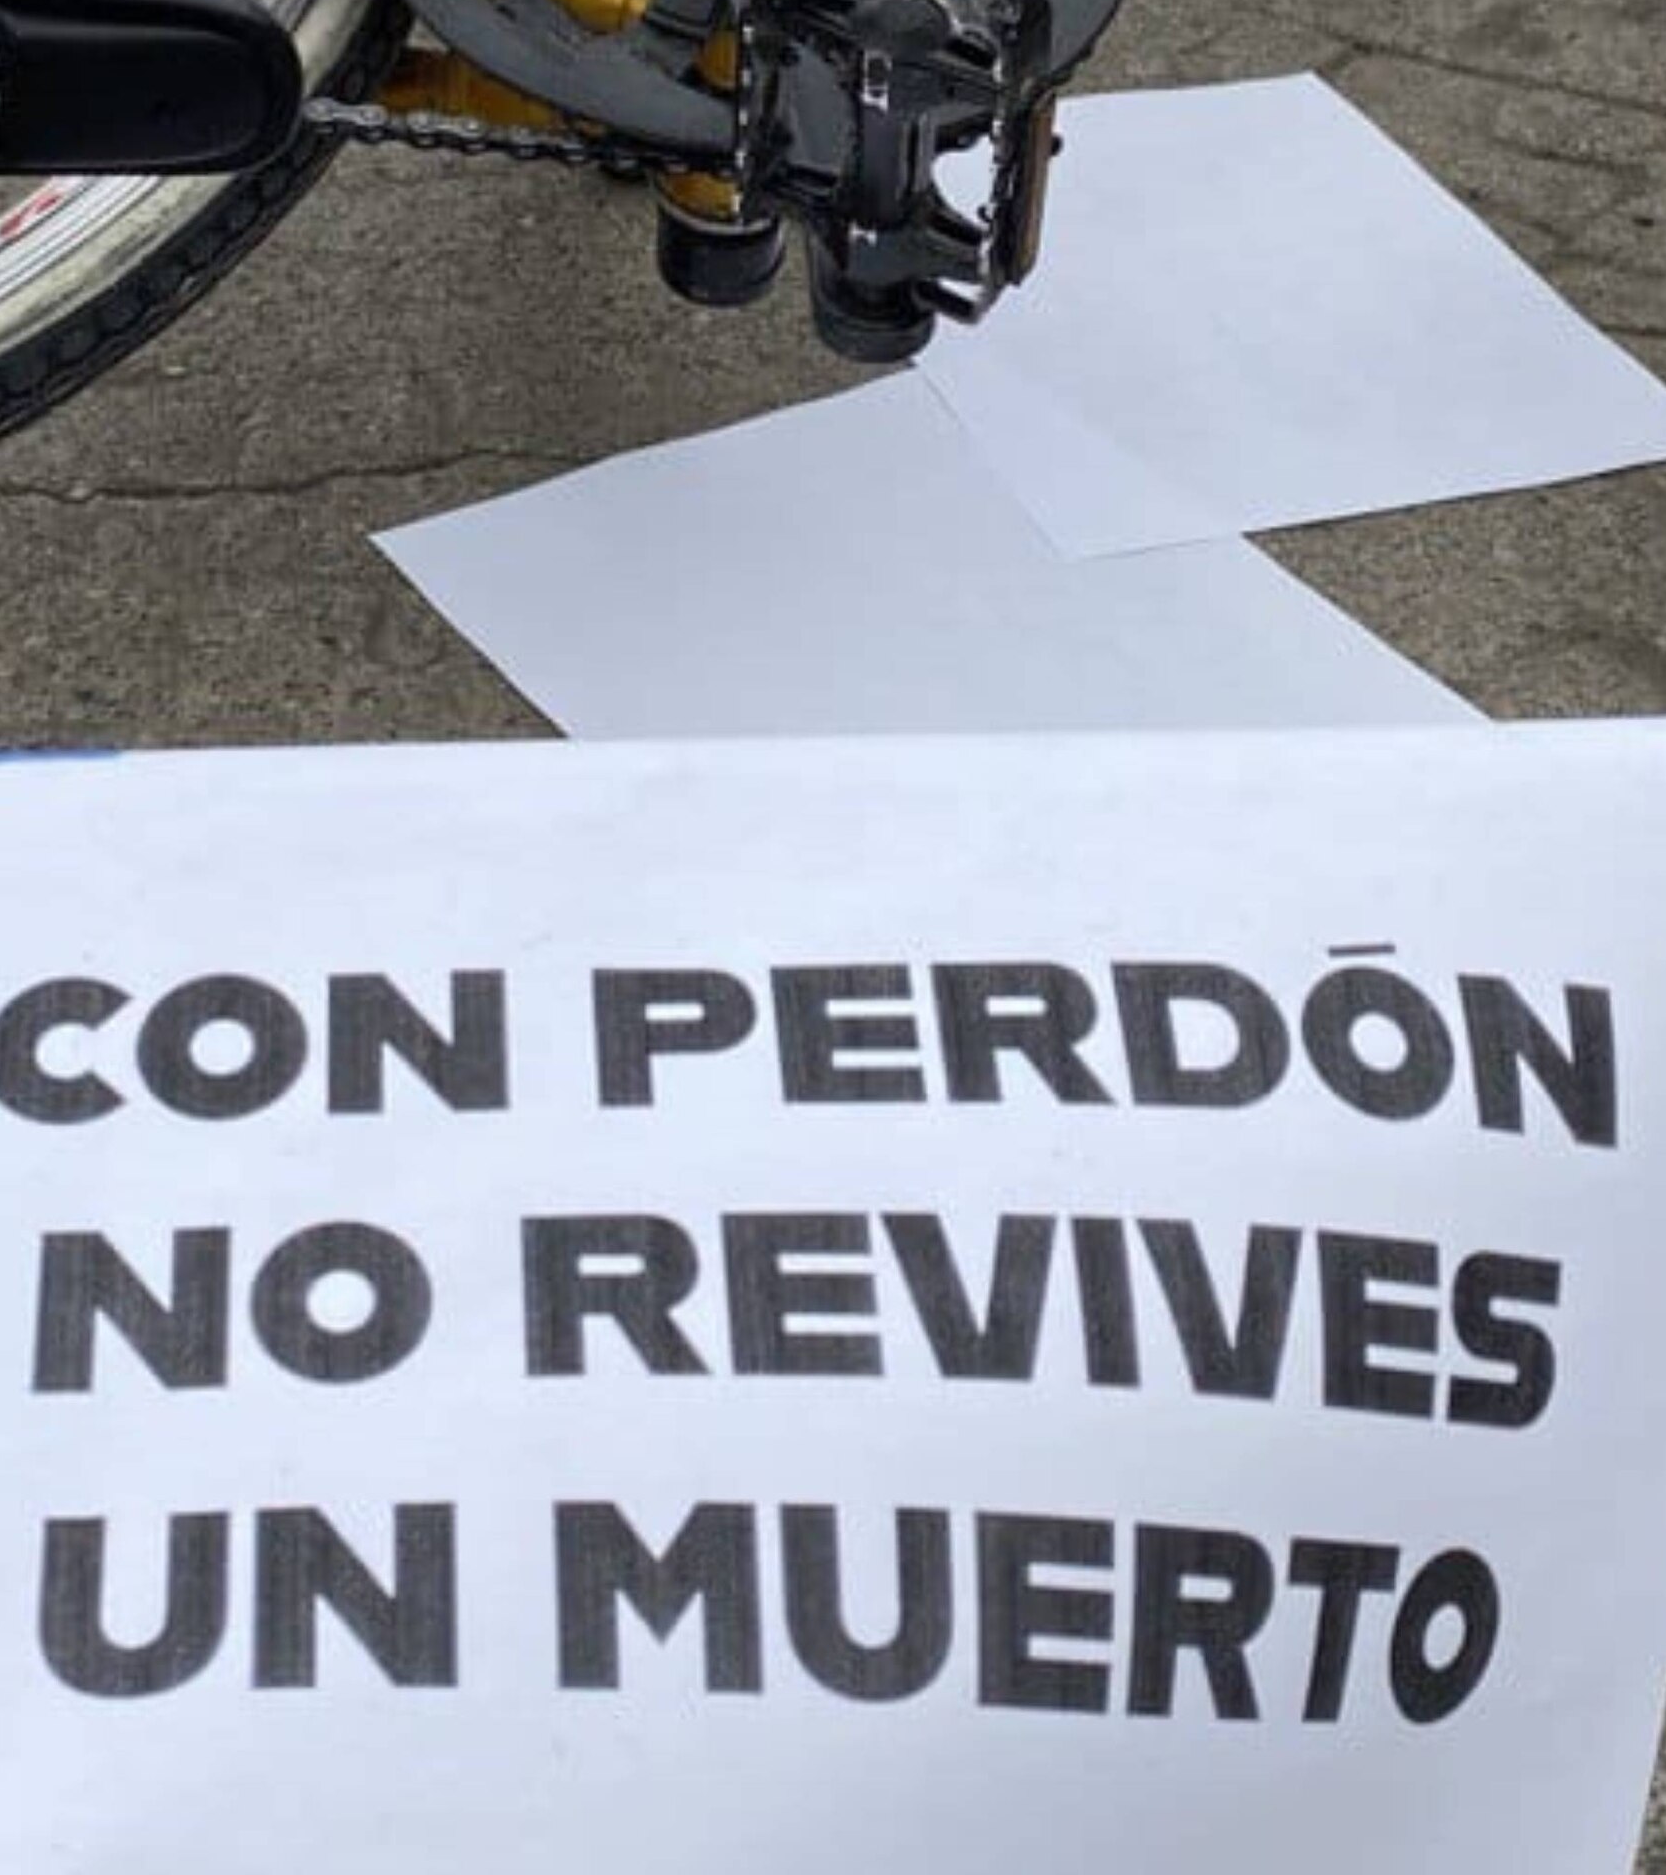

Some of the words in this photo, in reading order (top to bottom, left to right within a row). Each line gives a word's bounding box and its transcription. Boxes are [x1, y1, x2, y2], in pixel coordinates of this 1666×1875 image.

[33, 1221, 432, 1393] NO
[521, 1212, 1562, 1431] REVIVES
[39, 1502, 458, 1698] UN
[554, 1501, 1501, 1726] MUERTO
